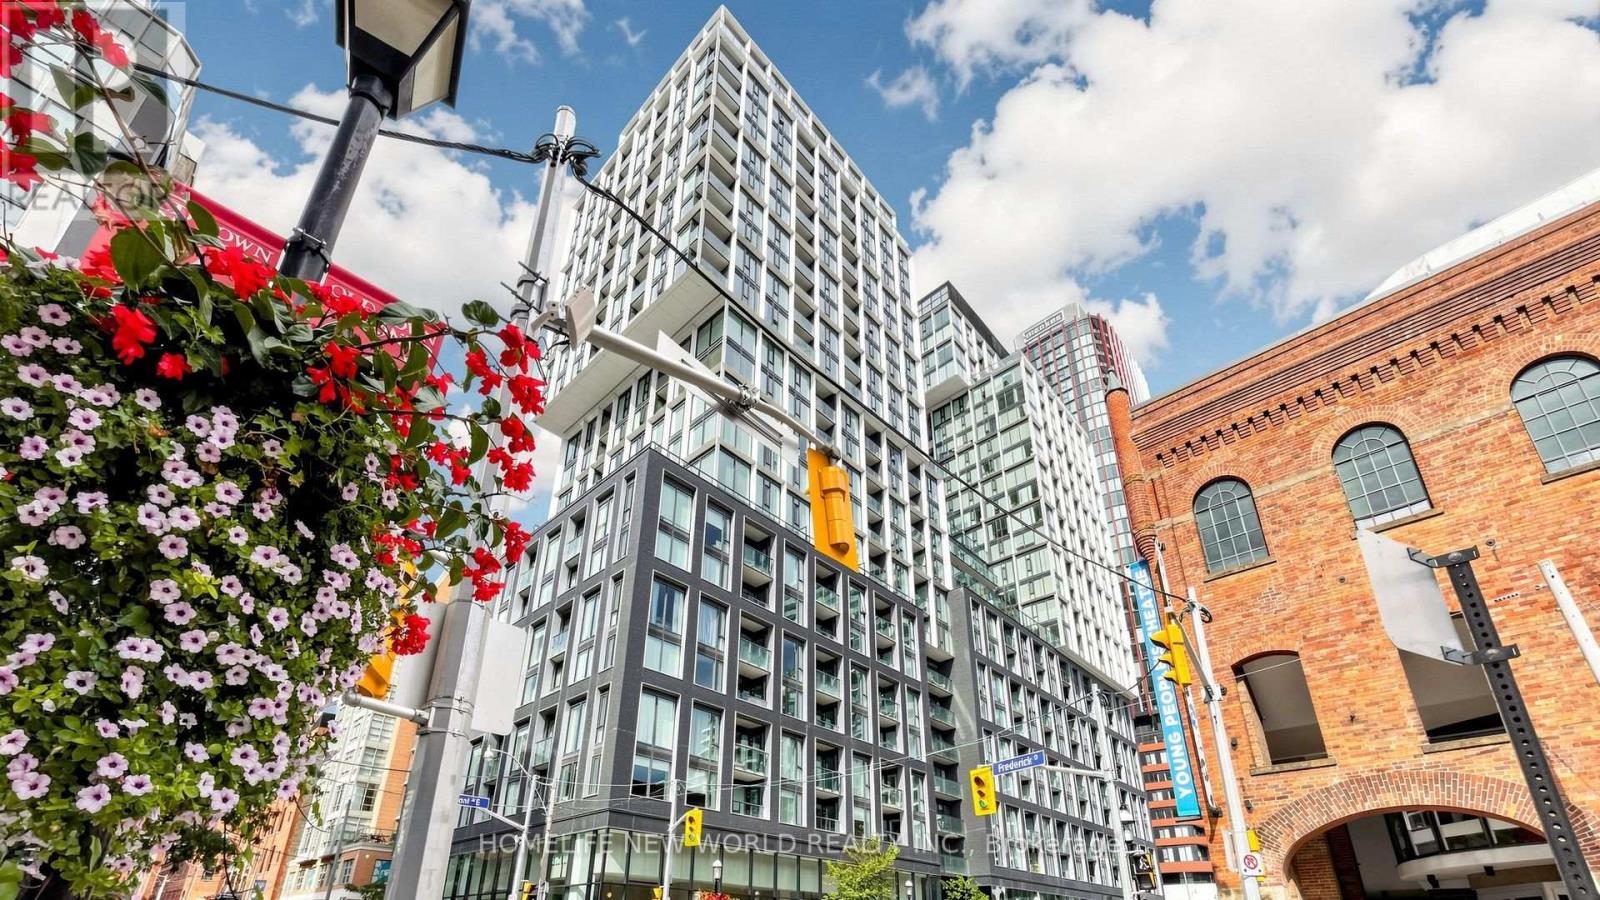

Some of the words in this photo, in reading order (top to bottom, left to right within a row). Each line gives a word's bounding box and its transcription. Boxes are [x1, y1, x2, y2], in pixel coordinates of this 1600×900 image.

[217, 226, 274, 265] OWN
[1135, 568, 1160, 637] HEATRE
[998, 756, 1033, 773] Frederick
[1168, 731, 1193, 799] YOUNG
